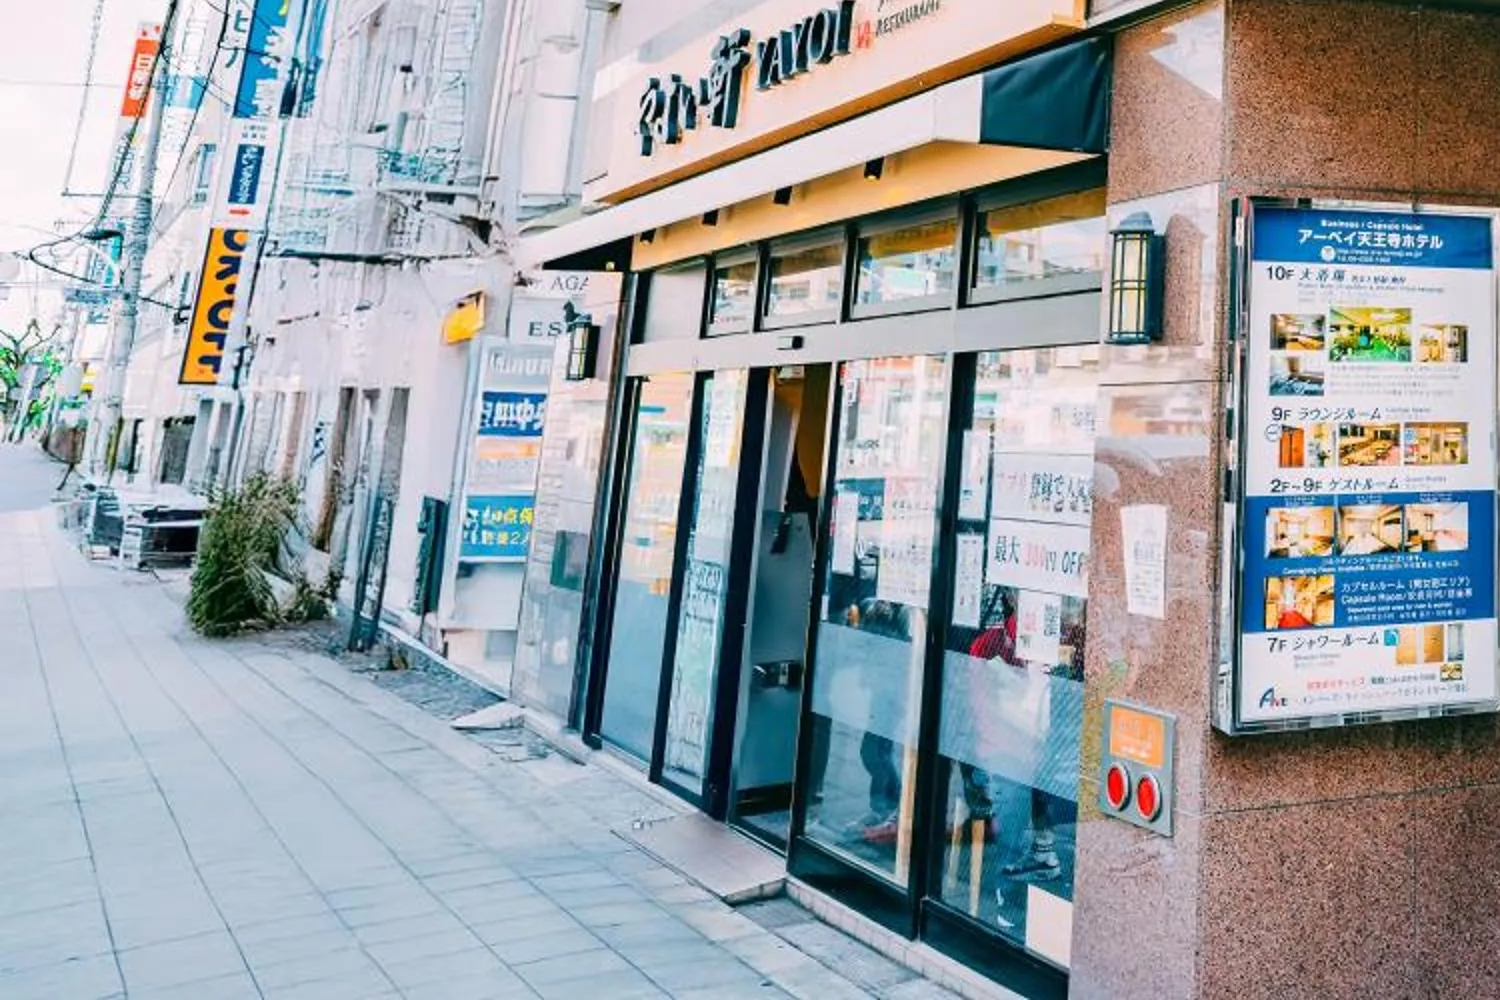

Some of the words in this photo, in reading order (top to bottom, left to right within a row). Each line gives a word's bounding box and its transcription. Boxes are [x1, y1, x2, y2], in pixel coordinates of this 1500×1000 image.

[1298, 229, 1444, 249] アーベイ天王寺ホテル
[1266, 266, 1295, 281] 10F
[1271, 407, 1292, 421] 9F
[1299, 407, 1381, 420] ラウンジルーム
[1329, 477, 1399, 491] ゲストルーム
[1267, 637, 1288, 653] 7F
[1292, 632, 1380, 651] シャワールーム
